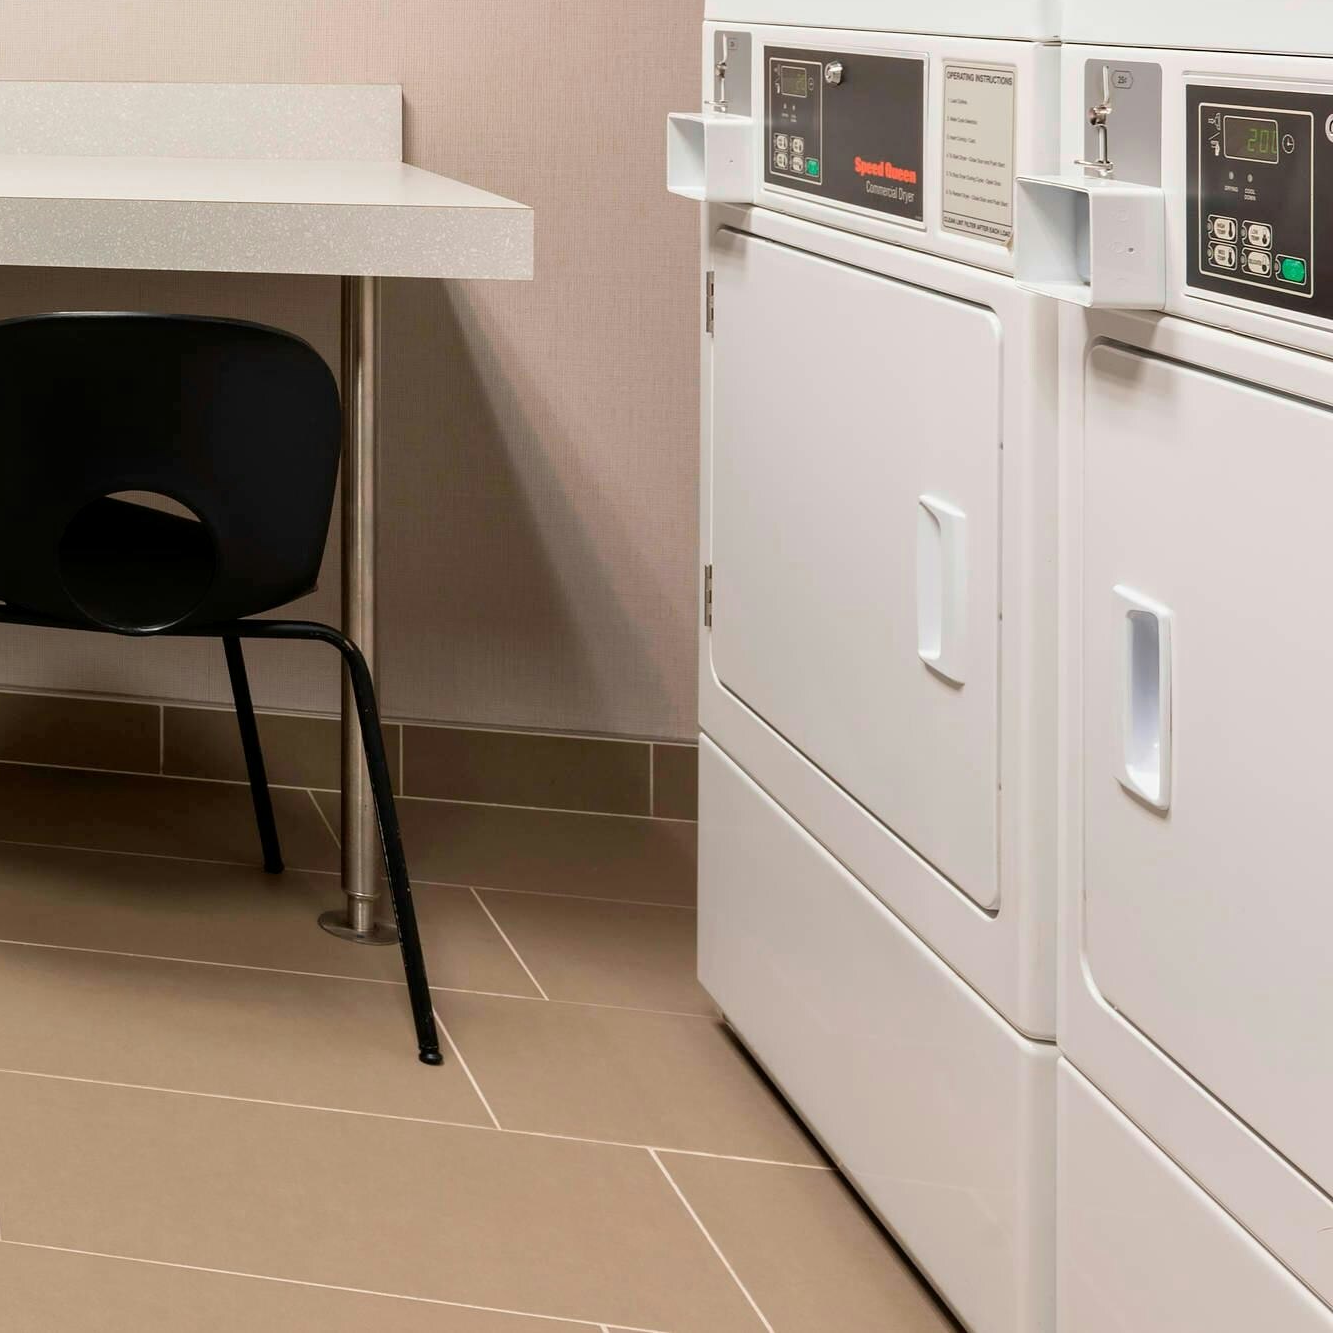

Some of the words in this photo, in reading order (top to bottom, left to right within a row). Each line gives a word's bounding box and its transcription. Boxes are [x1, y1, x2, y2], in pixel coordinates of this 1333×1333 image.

[975, 74, 1012, 85] INSTRUCTIONS
[855, 156, 884, 177] Speed
[885, 162, 916, 183] Queen
[866, 180, 897, 198] Commercial
[899, 187, 914, 204] Dryer
